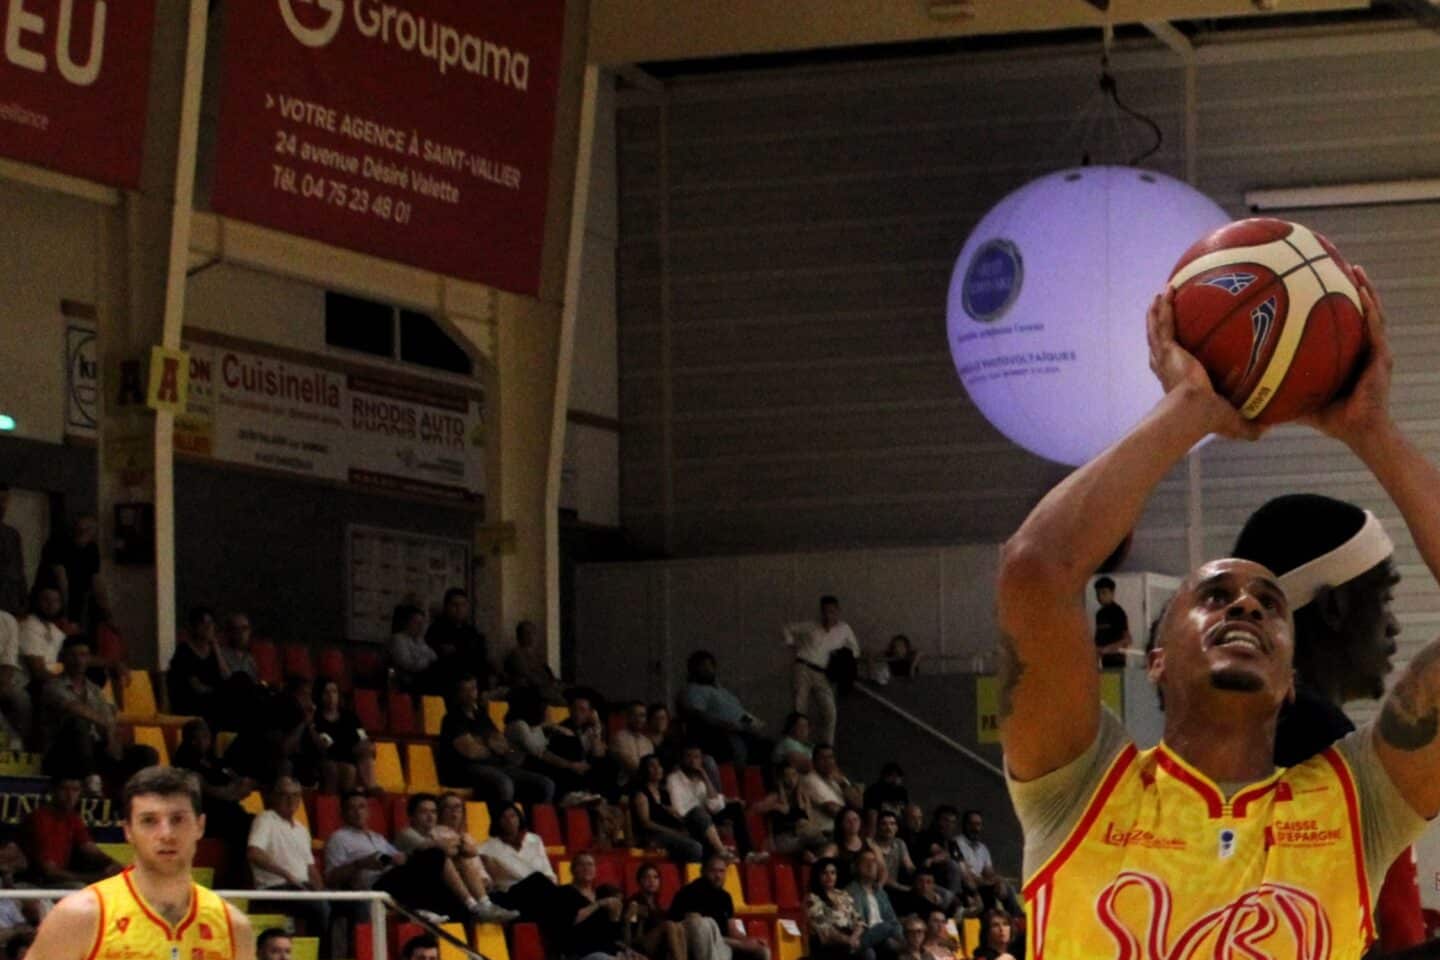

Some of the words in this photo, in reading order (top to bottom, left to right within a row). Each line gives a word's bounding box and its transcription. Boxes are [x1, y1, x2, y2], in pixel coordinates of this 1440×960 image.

[353, 0, 530, 92] Groupama
[275, 130, 297, 158] 24
[301, 139, 359, 174] avenue
[362, 155, 408, 190] Désiré
[411, 169, 460, 203] Valette
[279, 93, 337, 132] VOTRE
[340, 114, 405, 154] AGENCE
[423, 138, 522, 190] SAINT-VALLIER
[302, 173, 325, 200] 04
[328, 181, 347, 206] 75
[221, 353, 342, 408] Cuisinella
[352, 397, 416, 426] RHODIS
[420, 412, 466, 436] AUTO
